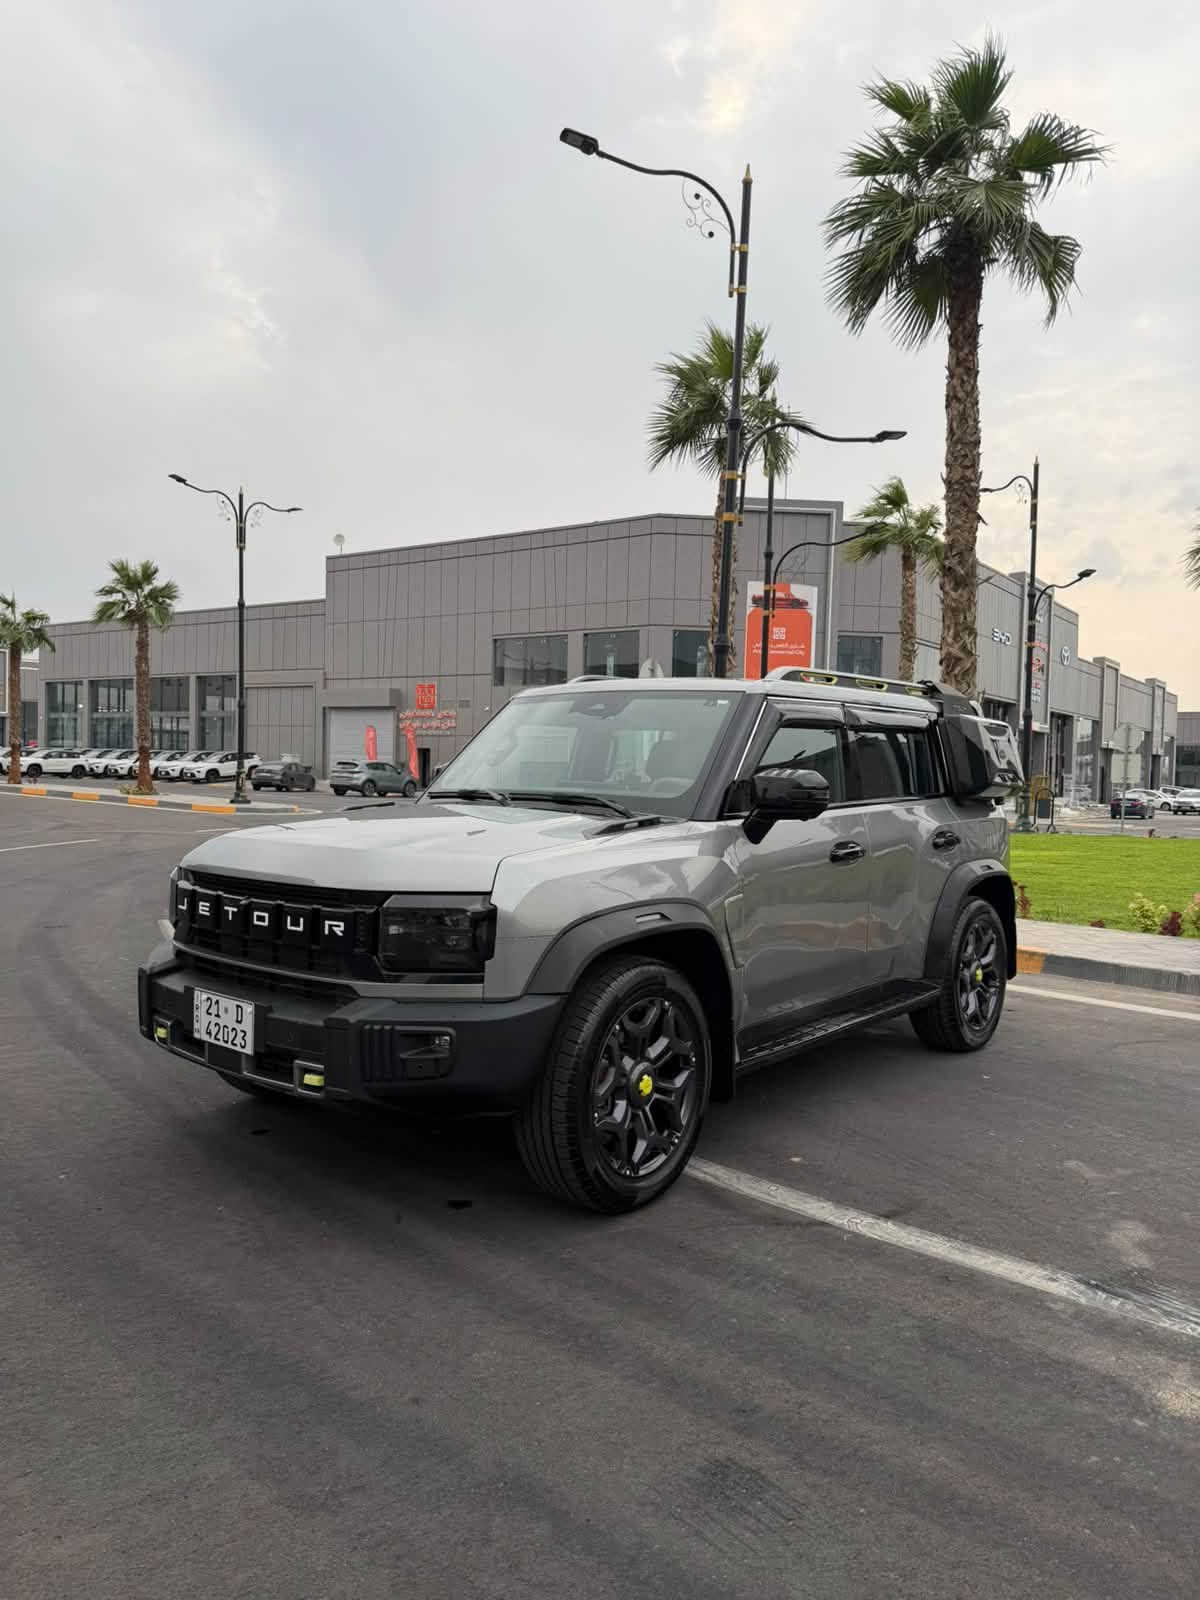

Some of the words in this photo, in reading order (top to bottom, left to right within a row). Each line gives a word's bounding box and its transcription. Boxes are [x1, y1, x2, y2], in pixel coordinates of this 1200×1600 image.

[992, 628, 1012, 645] BYD
[178, 897, 345, 936] JETOUR
[206, 996, 221, 1019] 21
[236, 1004, 243, 1024] D
[205, 1020, 248, 1049] 42023
